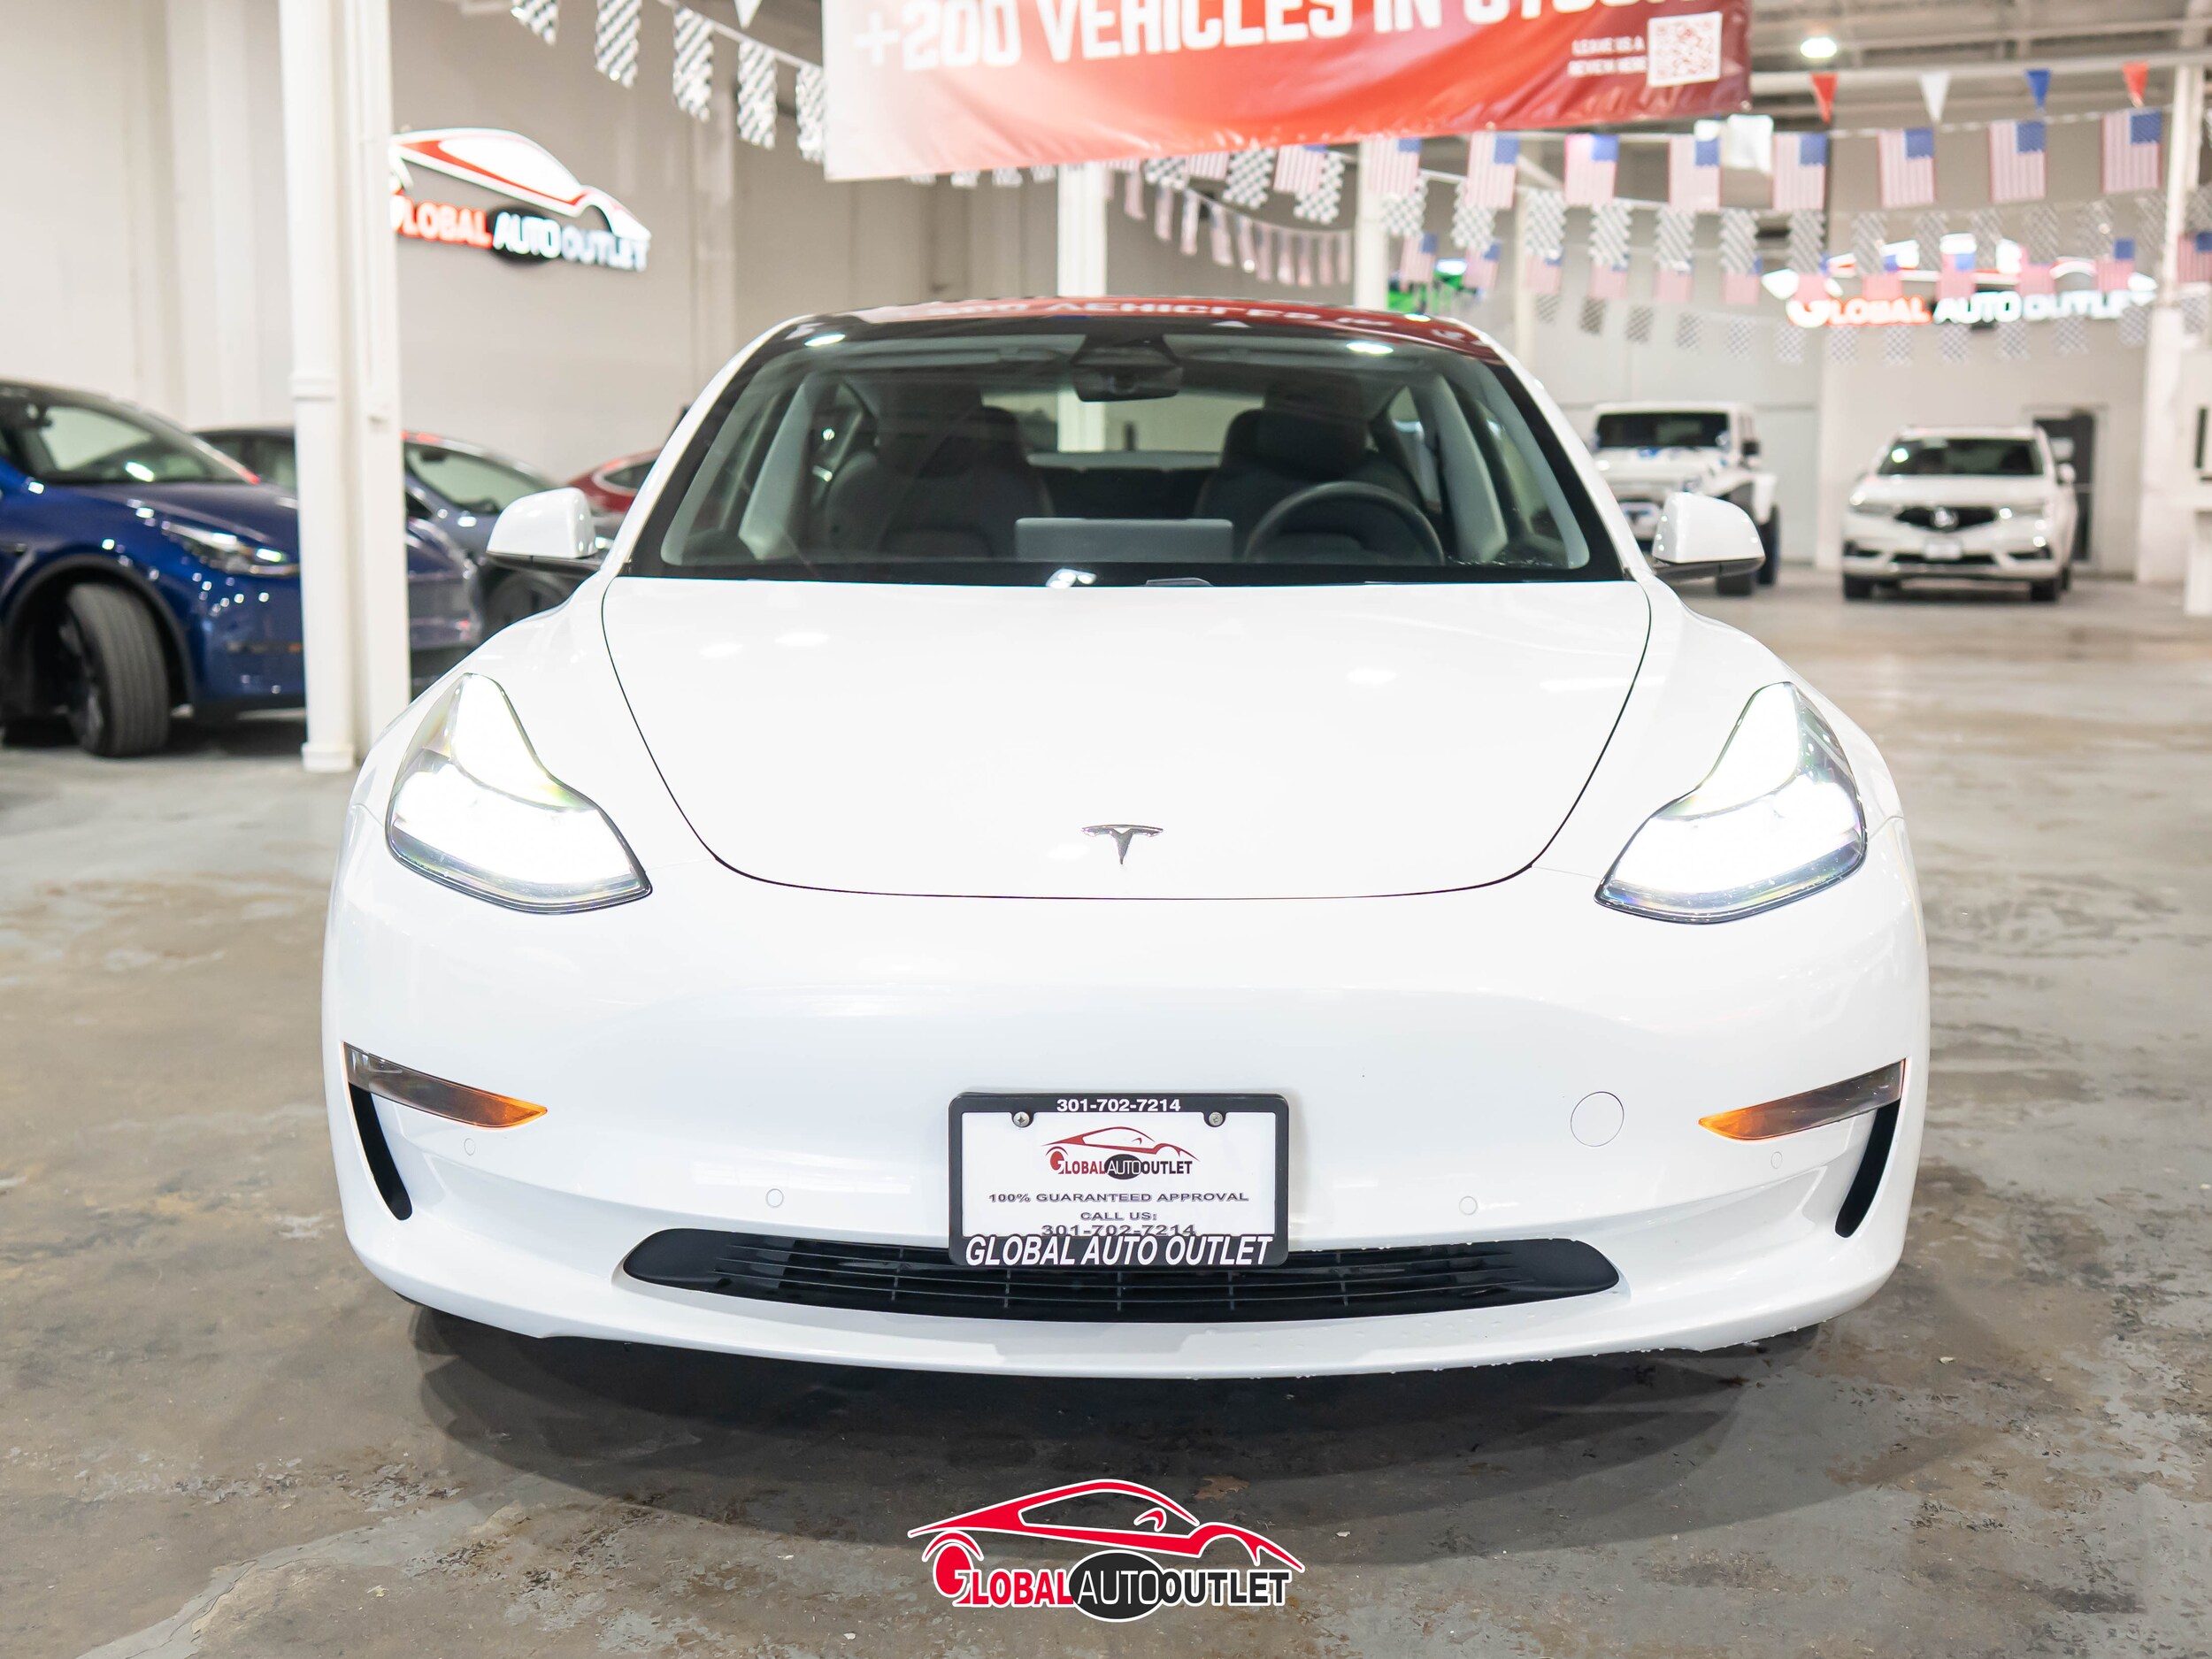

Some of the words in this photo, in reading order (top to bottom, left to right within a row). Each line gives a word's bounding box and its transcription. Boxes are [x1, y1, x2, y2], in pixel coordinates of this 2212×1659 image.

[852, 0, 1021, 71] +200
[1035, 0, 1352, 63] VEHICLES
[493, 211, 562, 258] AUTO
[1932, 290, 2022, 325] AUTO
[1056, 1098, 1181, 1112] 301-702-7214
[988, 1193, 1031, 1203] 100%
[1036, 1193, 1152, 1202] GUARANTEED
[1156, 1192, 1249, 1202] APPROVAL
[1080, 1211, 1125, 1221] CALL
[1129, 1211, 1157, 1221] US:
[1041, 1225, 1197, 1237] 301-702-7214
[965, 1235, 1076, 1266] GLOBAL
[1079, 1235, 1159, 1266] AUTO
[1164, 1234, 1274, 1266] OUTLET
